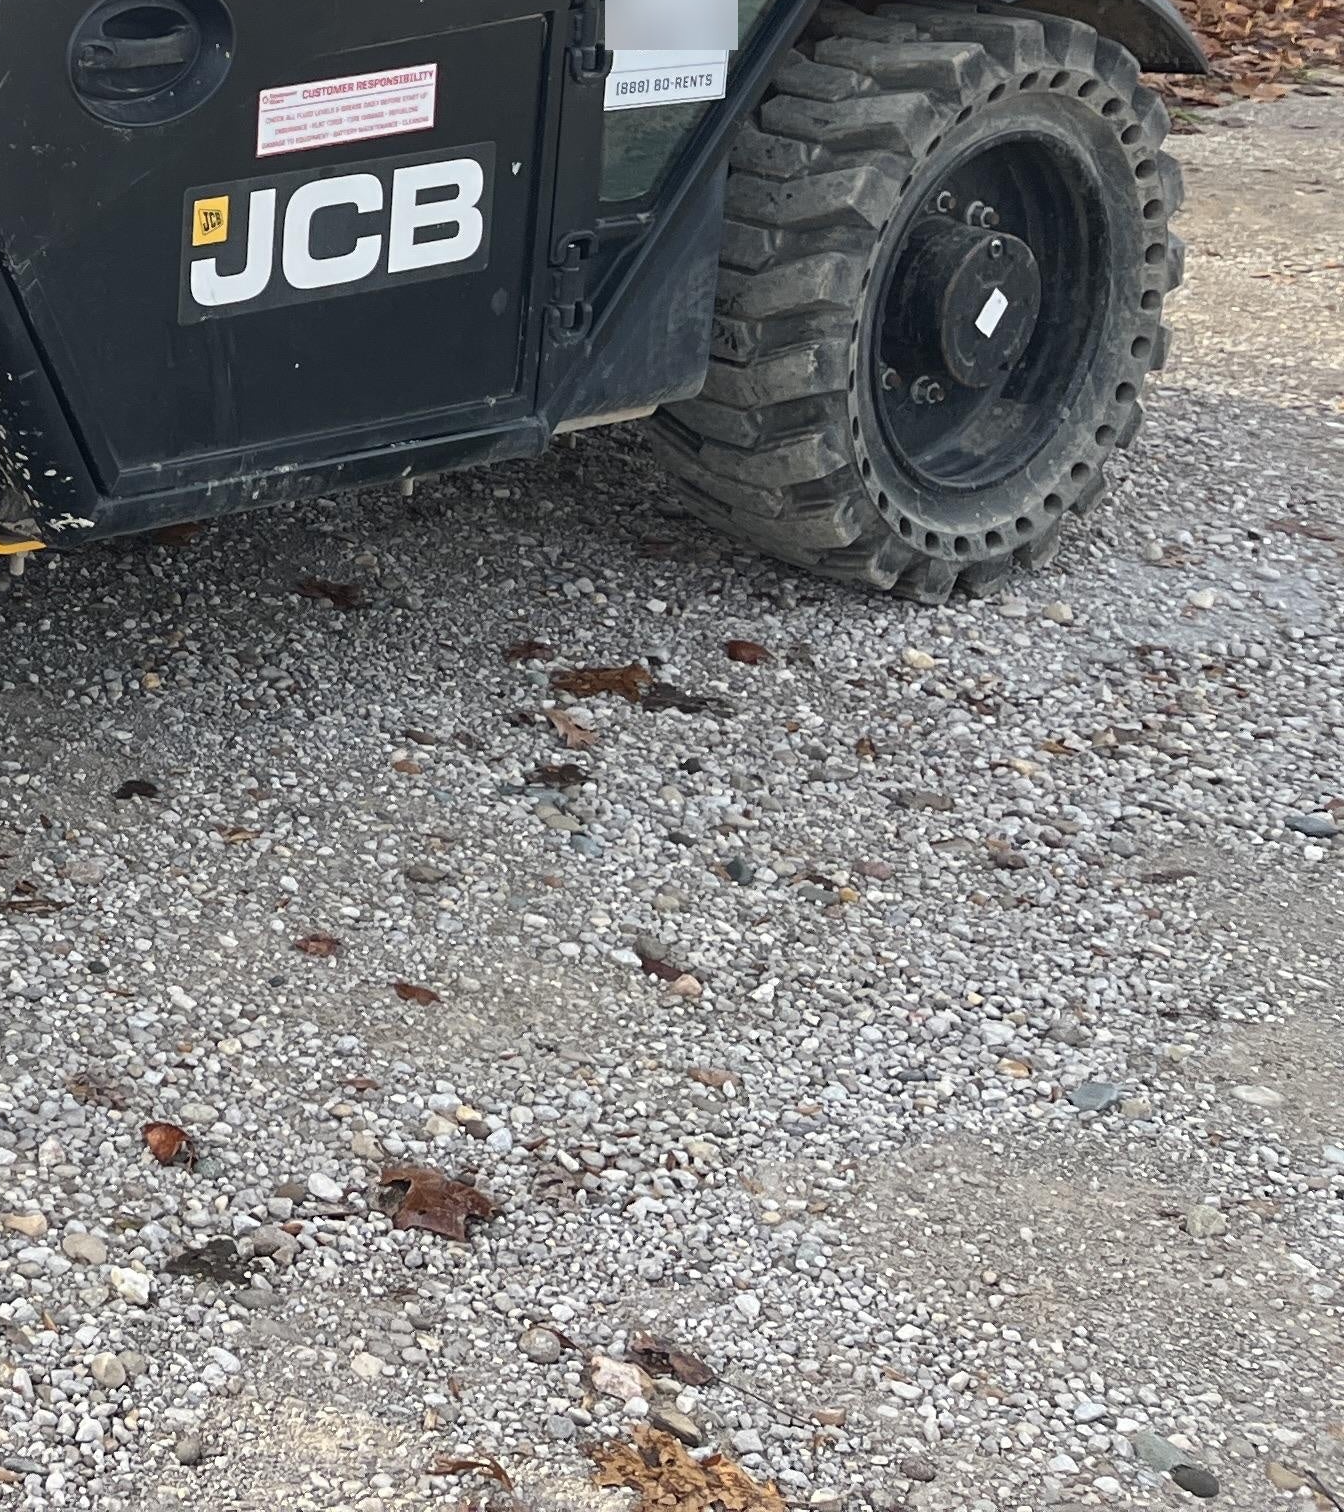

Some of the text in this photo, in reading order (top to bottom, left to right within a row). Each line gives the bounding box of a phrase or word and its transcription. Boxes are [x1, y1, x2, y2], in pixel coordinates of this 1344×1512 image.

[302, 82, 354, 99] CUSTOMER
[357, 70, 433, 91] RESPONSIBILITY
[190, 159, 484, 306] JCB
[203, 211, 224, 232] JCB
